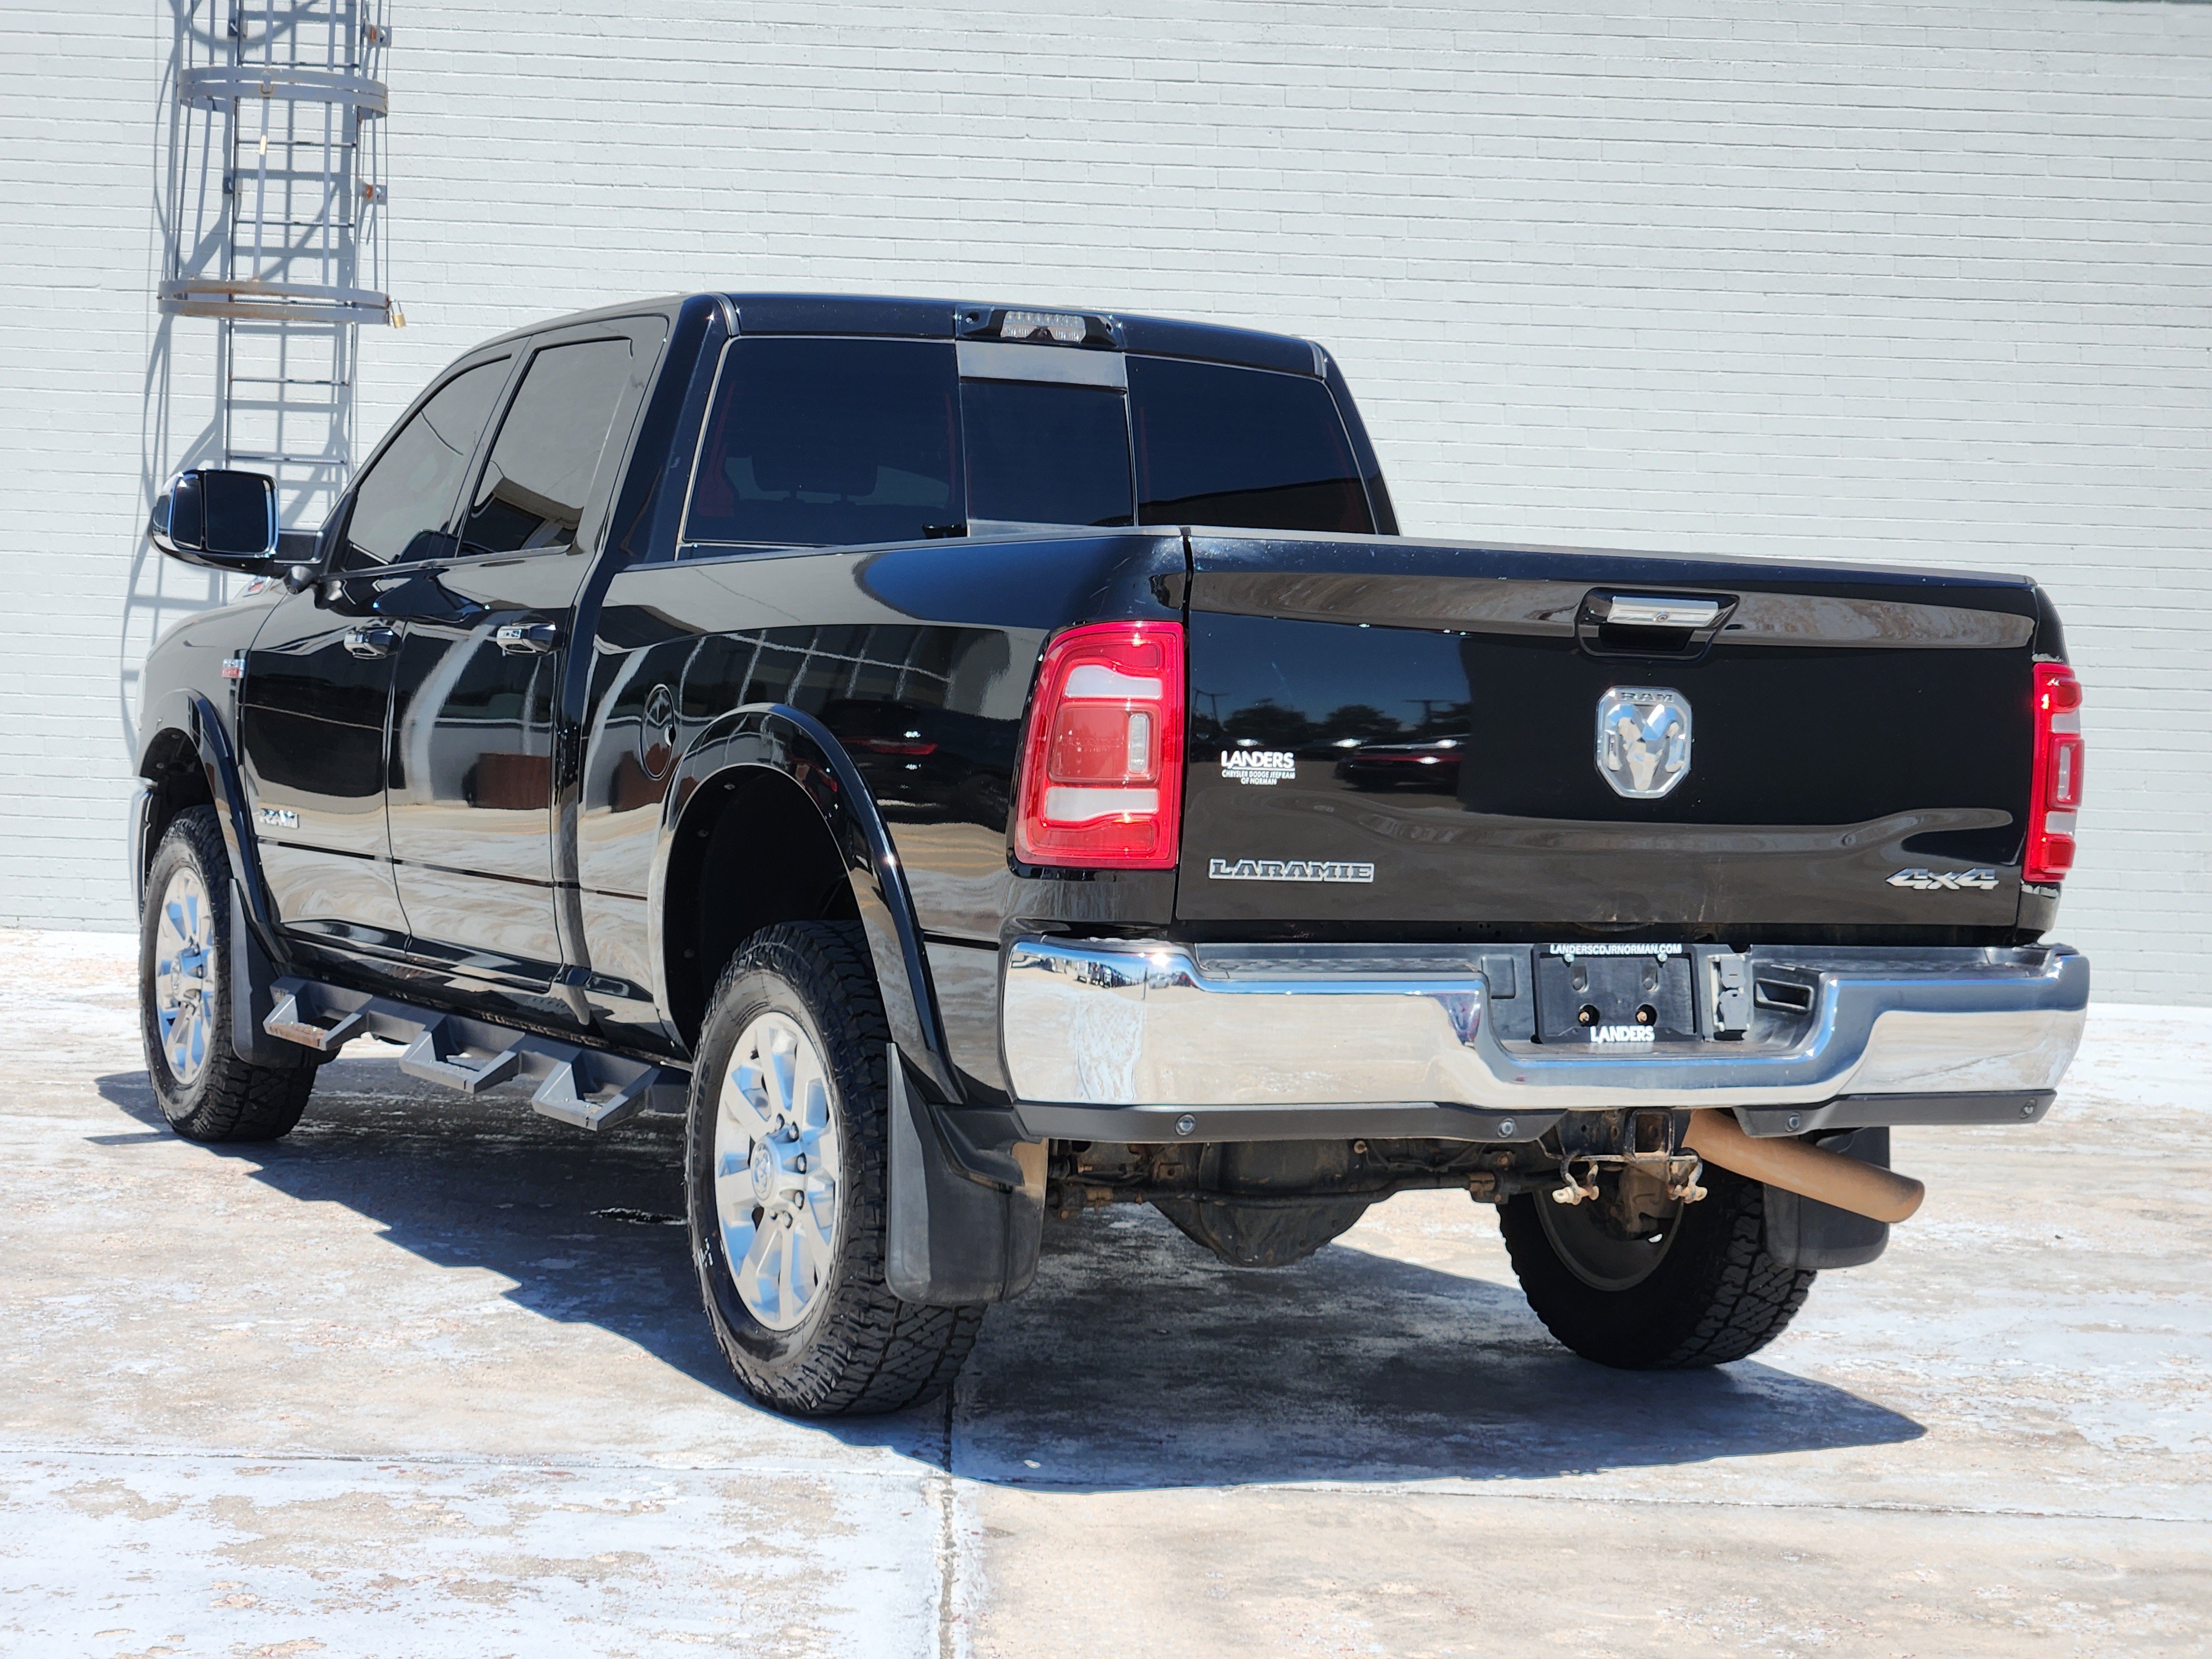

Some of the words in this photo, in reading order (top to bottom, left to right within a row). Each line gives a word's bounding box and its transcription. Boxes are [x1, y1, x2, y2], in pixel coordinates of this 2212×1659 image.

[1620, 692, 1674, 702] RAM
[1221, 750, 1295, 769] LANDERS
[1222, 769, 1248, 778] CHRYSLER
[1208, 858, 1374, 883] LARAMIE
[1550, 943, 1683, 954] LANDERSCDJRNORMAN.COM
[1590, 1025, 1655, 1043] LANDERS
